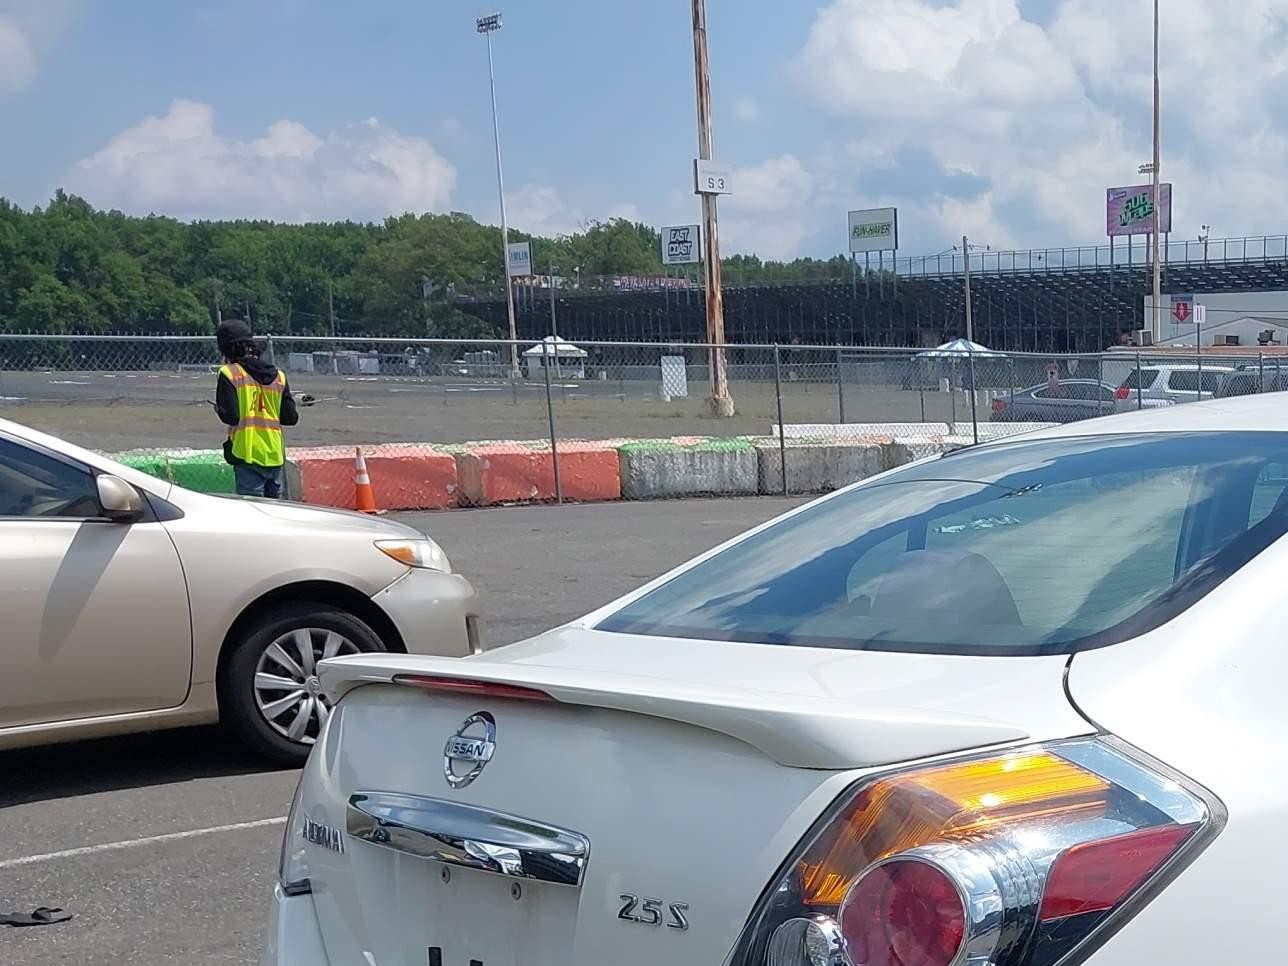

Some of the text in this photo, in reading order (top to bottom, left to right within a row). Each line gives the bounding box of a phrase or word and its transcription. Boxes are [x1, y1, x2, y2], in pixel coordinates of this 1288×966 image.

[707, 177, 725, 190] S 3
[669, 228, 690, 242] EAST
[667, 240, 693, 257] COAST
[446, 742, 486, 757] NISSAN
